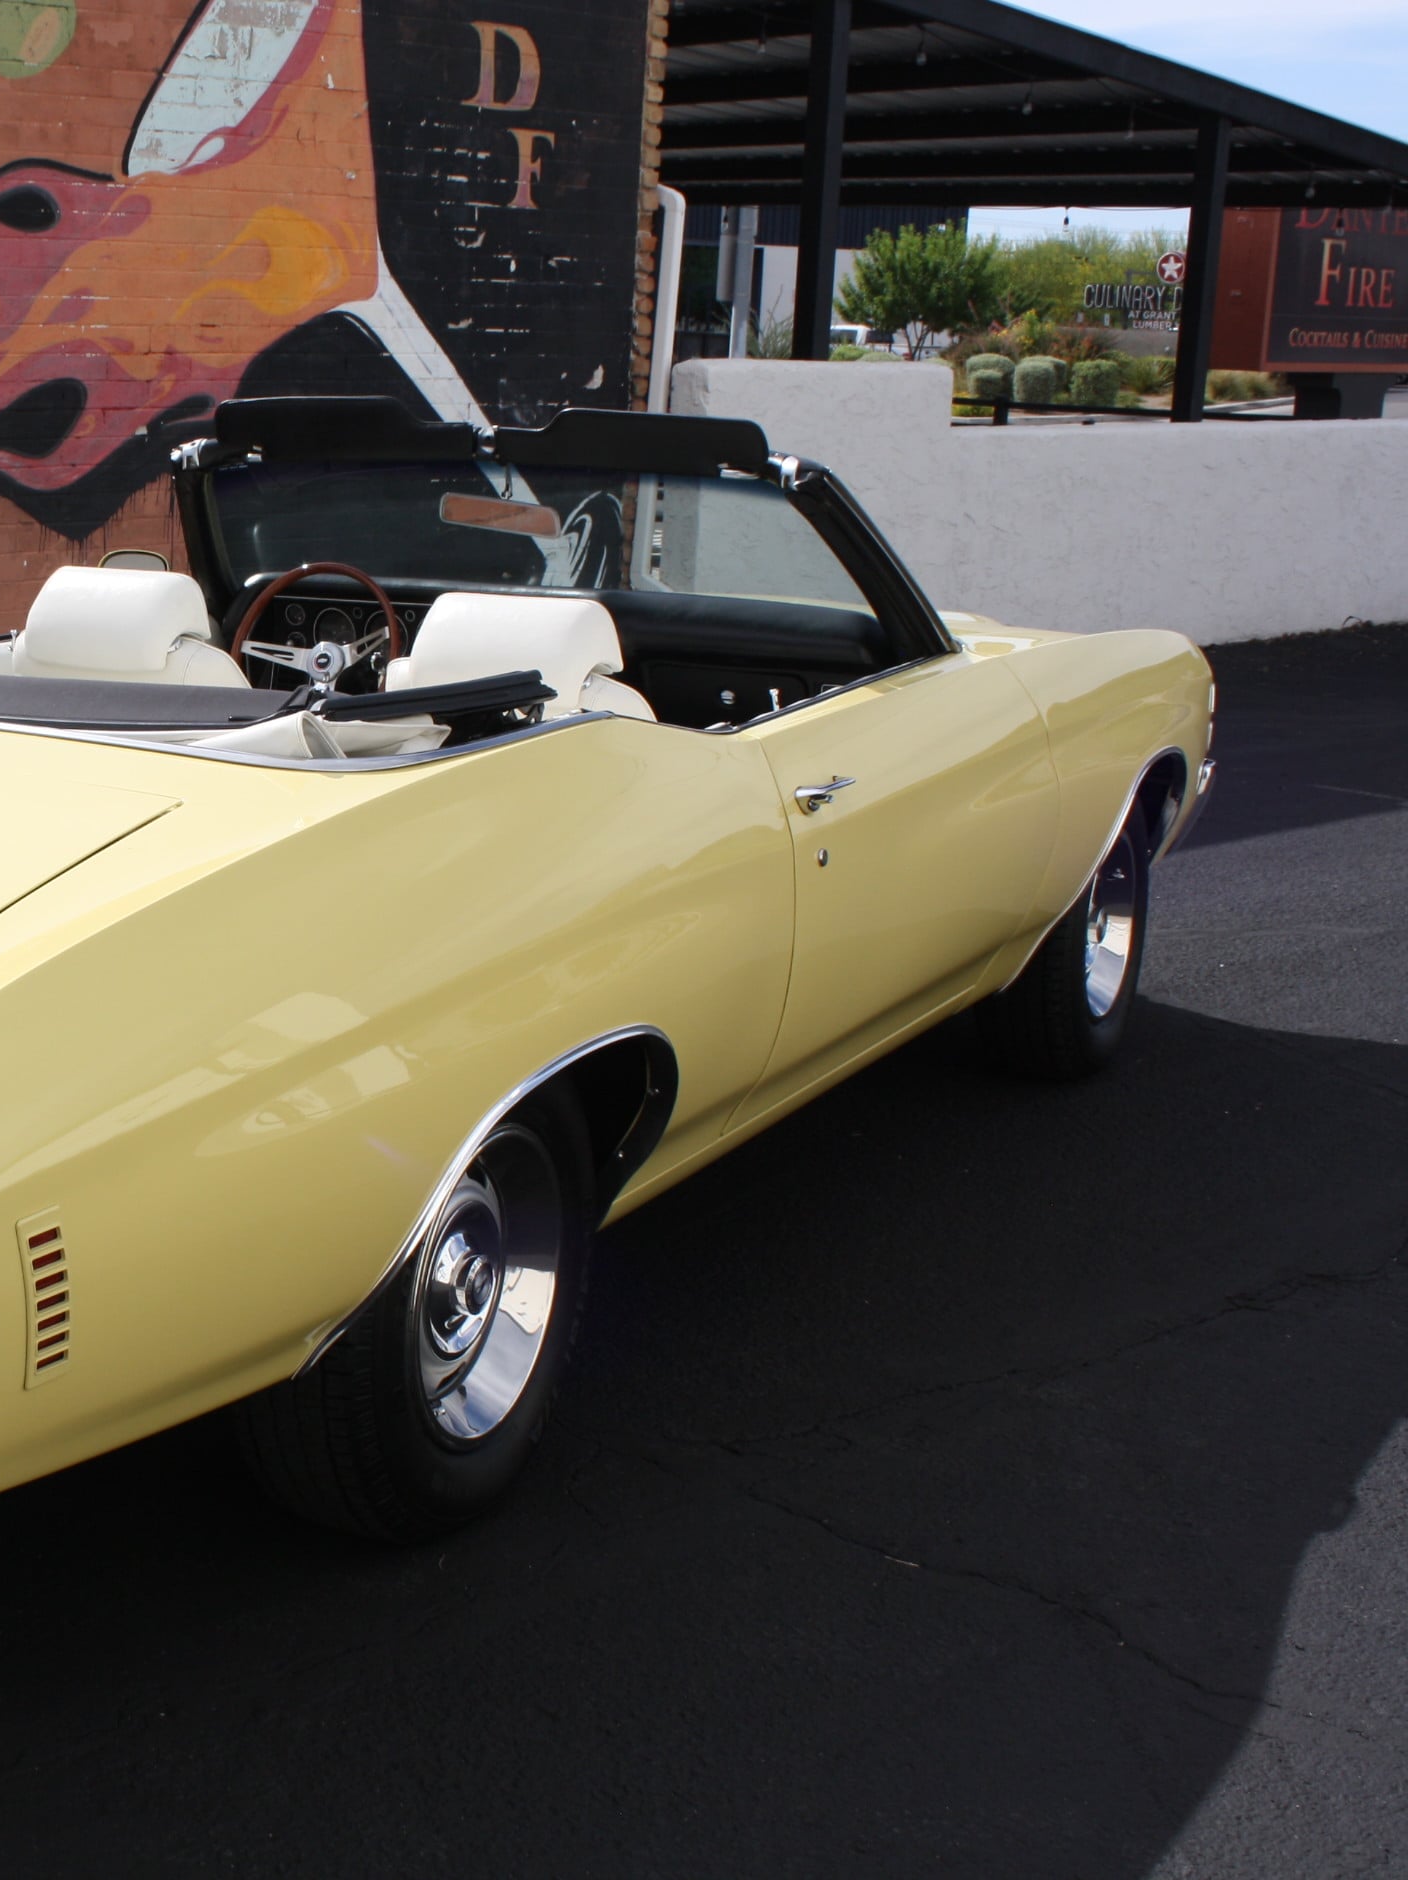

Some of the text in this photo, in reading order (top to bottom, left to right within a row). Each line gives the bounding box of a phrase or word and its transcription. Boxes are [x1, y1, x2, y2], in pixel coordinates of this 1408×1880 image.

[461, 21, 541, 111] D
[506, 127, 556, 210] F
[1314, 238, 1396, 308] FIRE
[1083, 283, 1166, 311] CULINARY
[1128, 310, 1177, 321] AT GRANT
[1132, 319, 1172, 330] LUMBER
[1289, 327, 1350, 348] COCKTAILS
[1352, 331, 1361, 348] &
